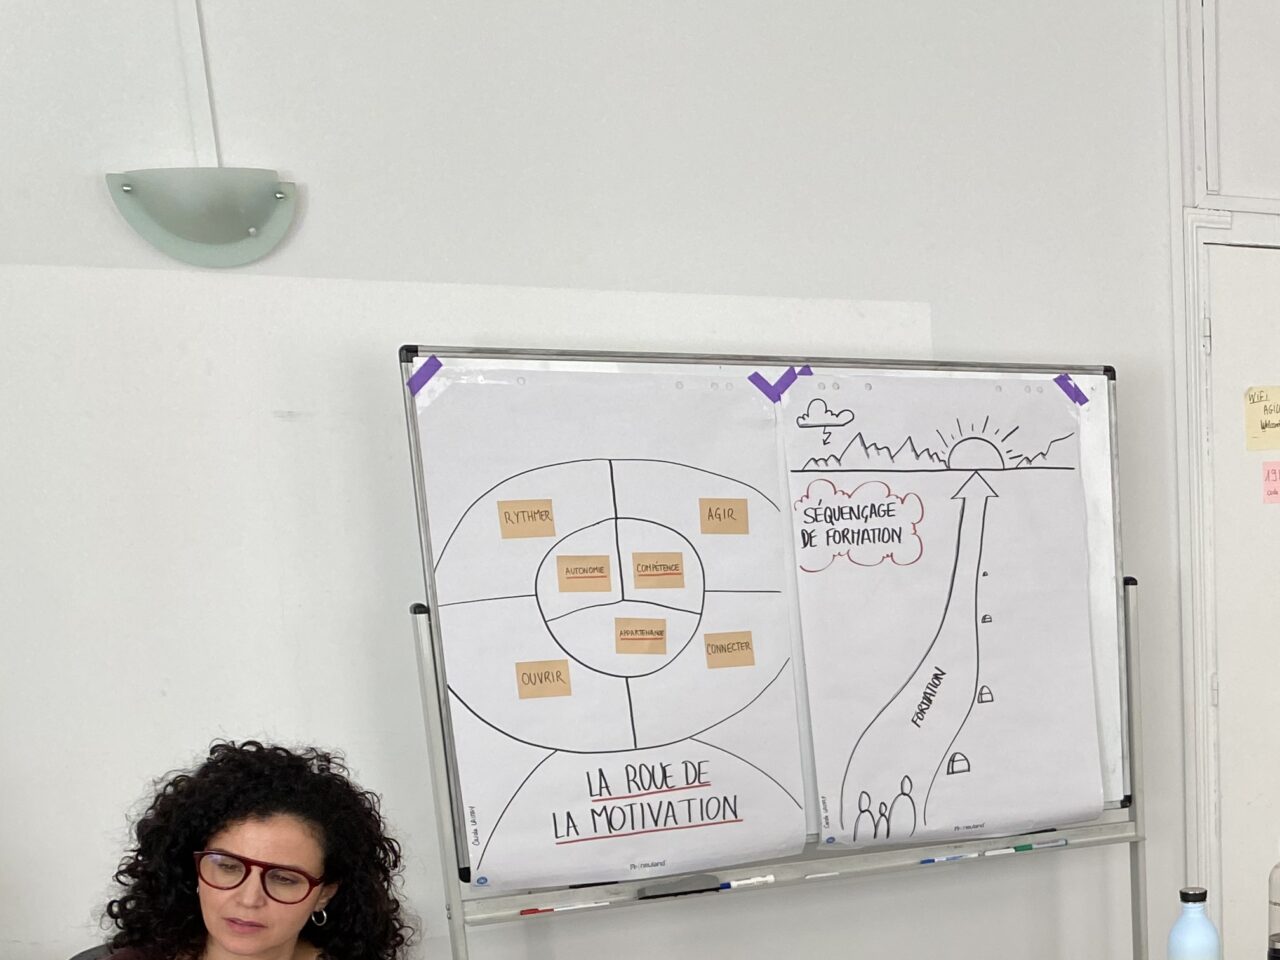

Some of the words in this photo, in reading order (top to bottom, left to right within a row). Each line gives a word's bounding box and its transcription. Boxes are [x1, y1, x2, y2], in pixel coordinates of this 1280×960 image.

[504, 509, 553, 524] RYTHMER
[706, 507, 738, 522] AGIR
[803, 499, 897, 524] SÉQUENÇAGE
[801, 528, 819, 549] DE
[825, 526, 902, 546] FORMATION
[565, 566, 605, 575] AUTONOMIE
[636, 560, 681, 573] COMPÉTENCE
[706, 641, 752, 655] CONNECTER
[521, 670, 568, 686] OUVRIR
[586, 768, 612, 797] LA
[625, 762, 676, 794] ROUE
[682, 760, 711, 785] DE
[552, 811, 580, 839] LA
[590, 794, 739, 834] MOTIVATION
